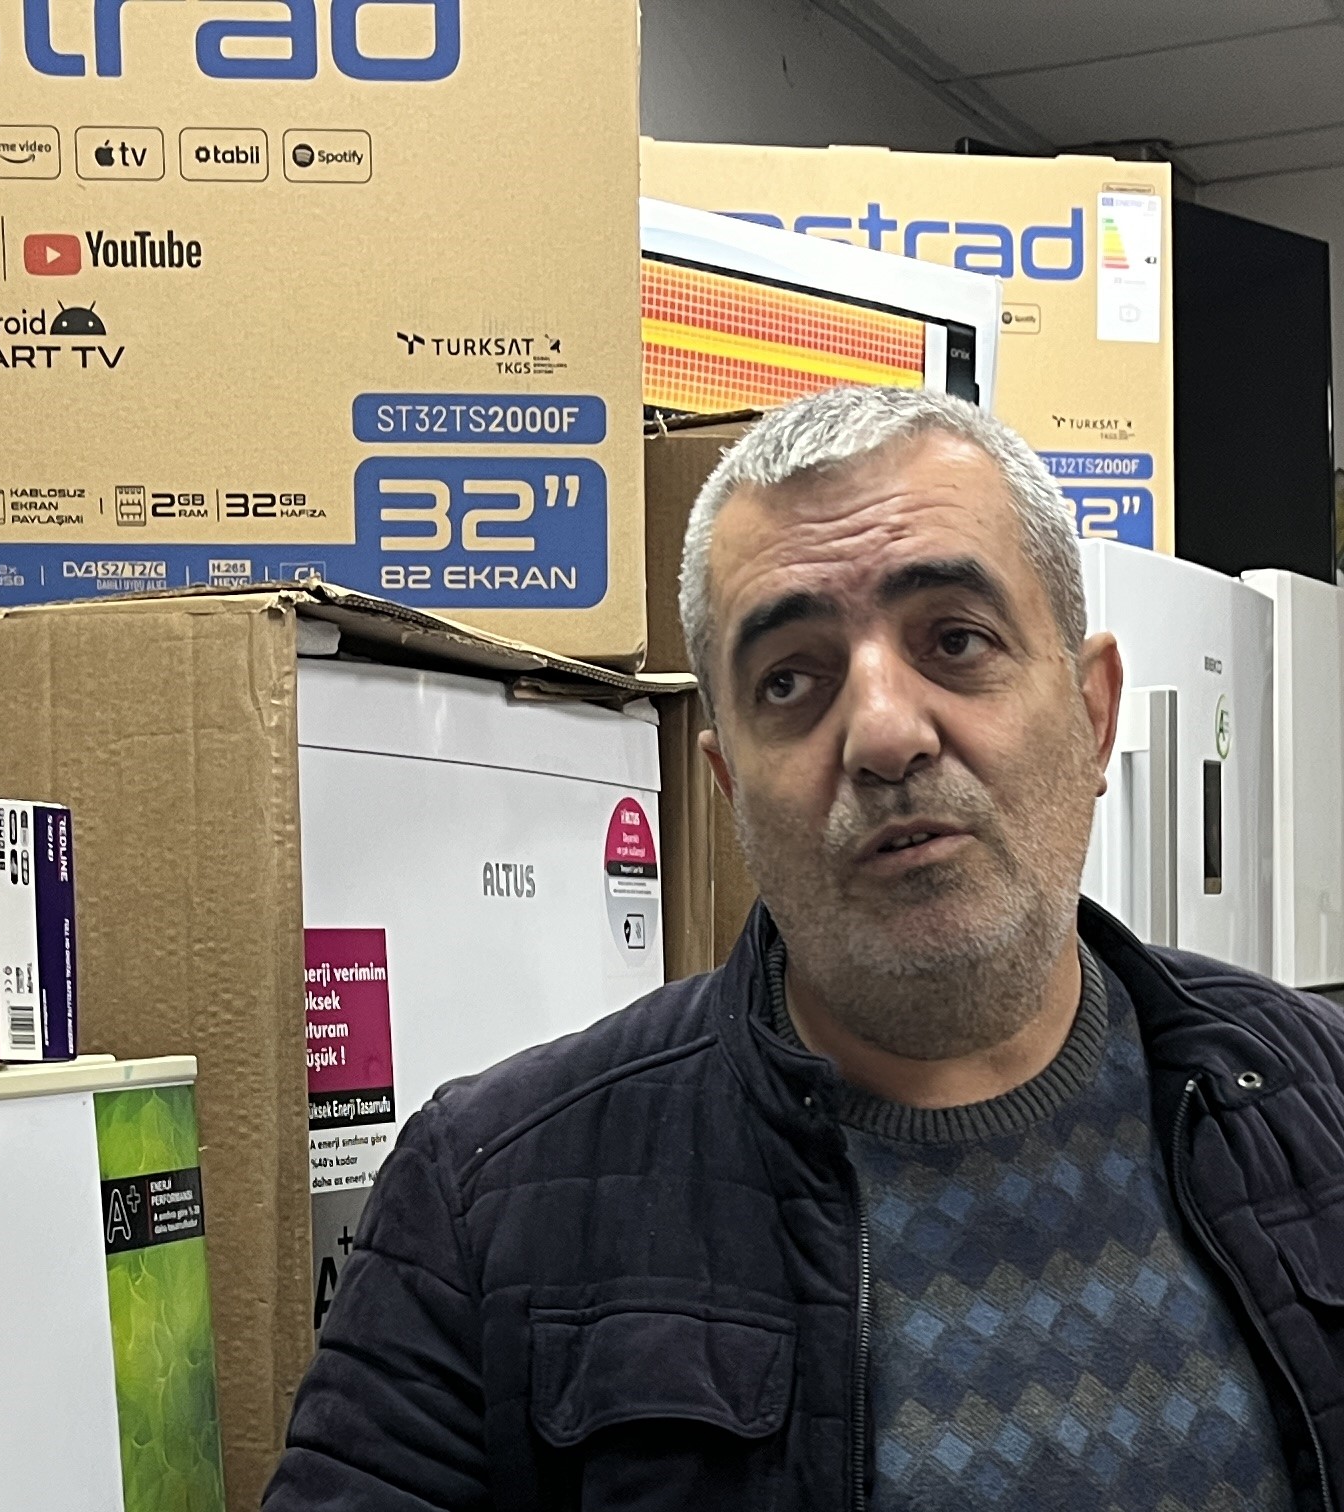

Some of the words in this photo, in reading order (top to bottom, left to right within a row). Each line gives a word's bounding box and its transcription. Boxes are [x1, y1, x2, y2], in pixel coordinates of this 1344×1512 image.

[18, 141, 52, 154] video
[120, 144, 147, 167] tv
[317, 149, 364, 166] Spotify
[85, 230, 203, 269] YouTube
[431, 338, 535, 356] TURKSAT
[71, 346, 125, 369] TV
[496, 362, 531, 374] TKGS
[377, 405, 579, 433] ST32TS2000F
[10, 488, 86, 498] KABLOSUZ
[178, 493, 205, 506] GB
[279, 493, 307, 507] GB
[10, 501, 58, 511] EKRAN
[178, 509, 208, 518] RAM
[225, 493, 276, 518] 32
[381, 566, 431, 589] 82
[443, 566, 577, 590] EKRAN
[483, 862, 536, 899] ALTUS
